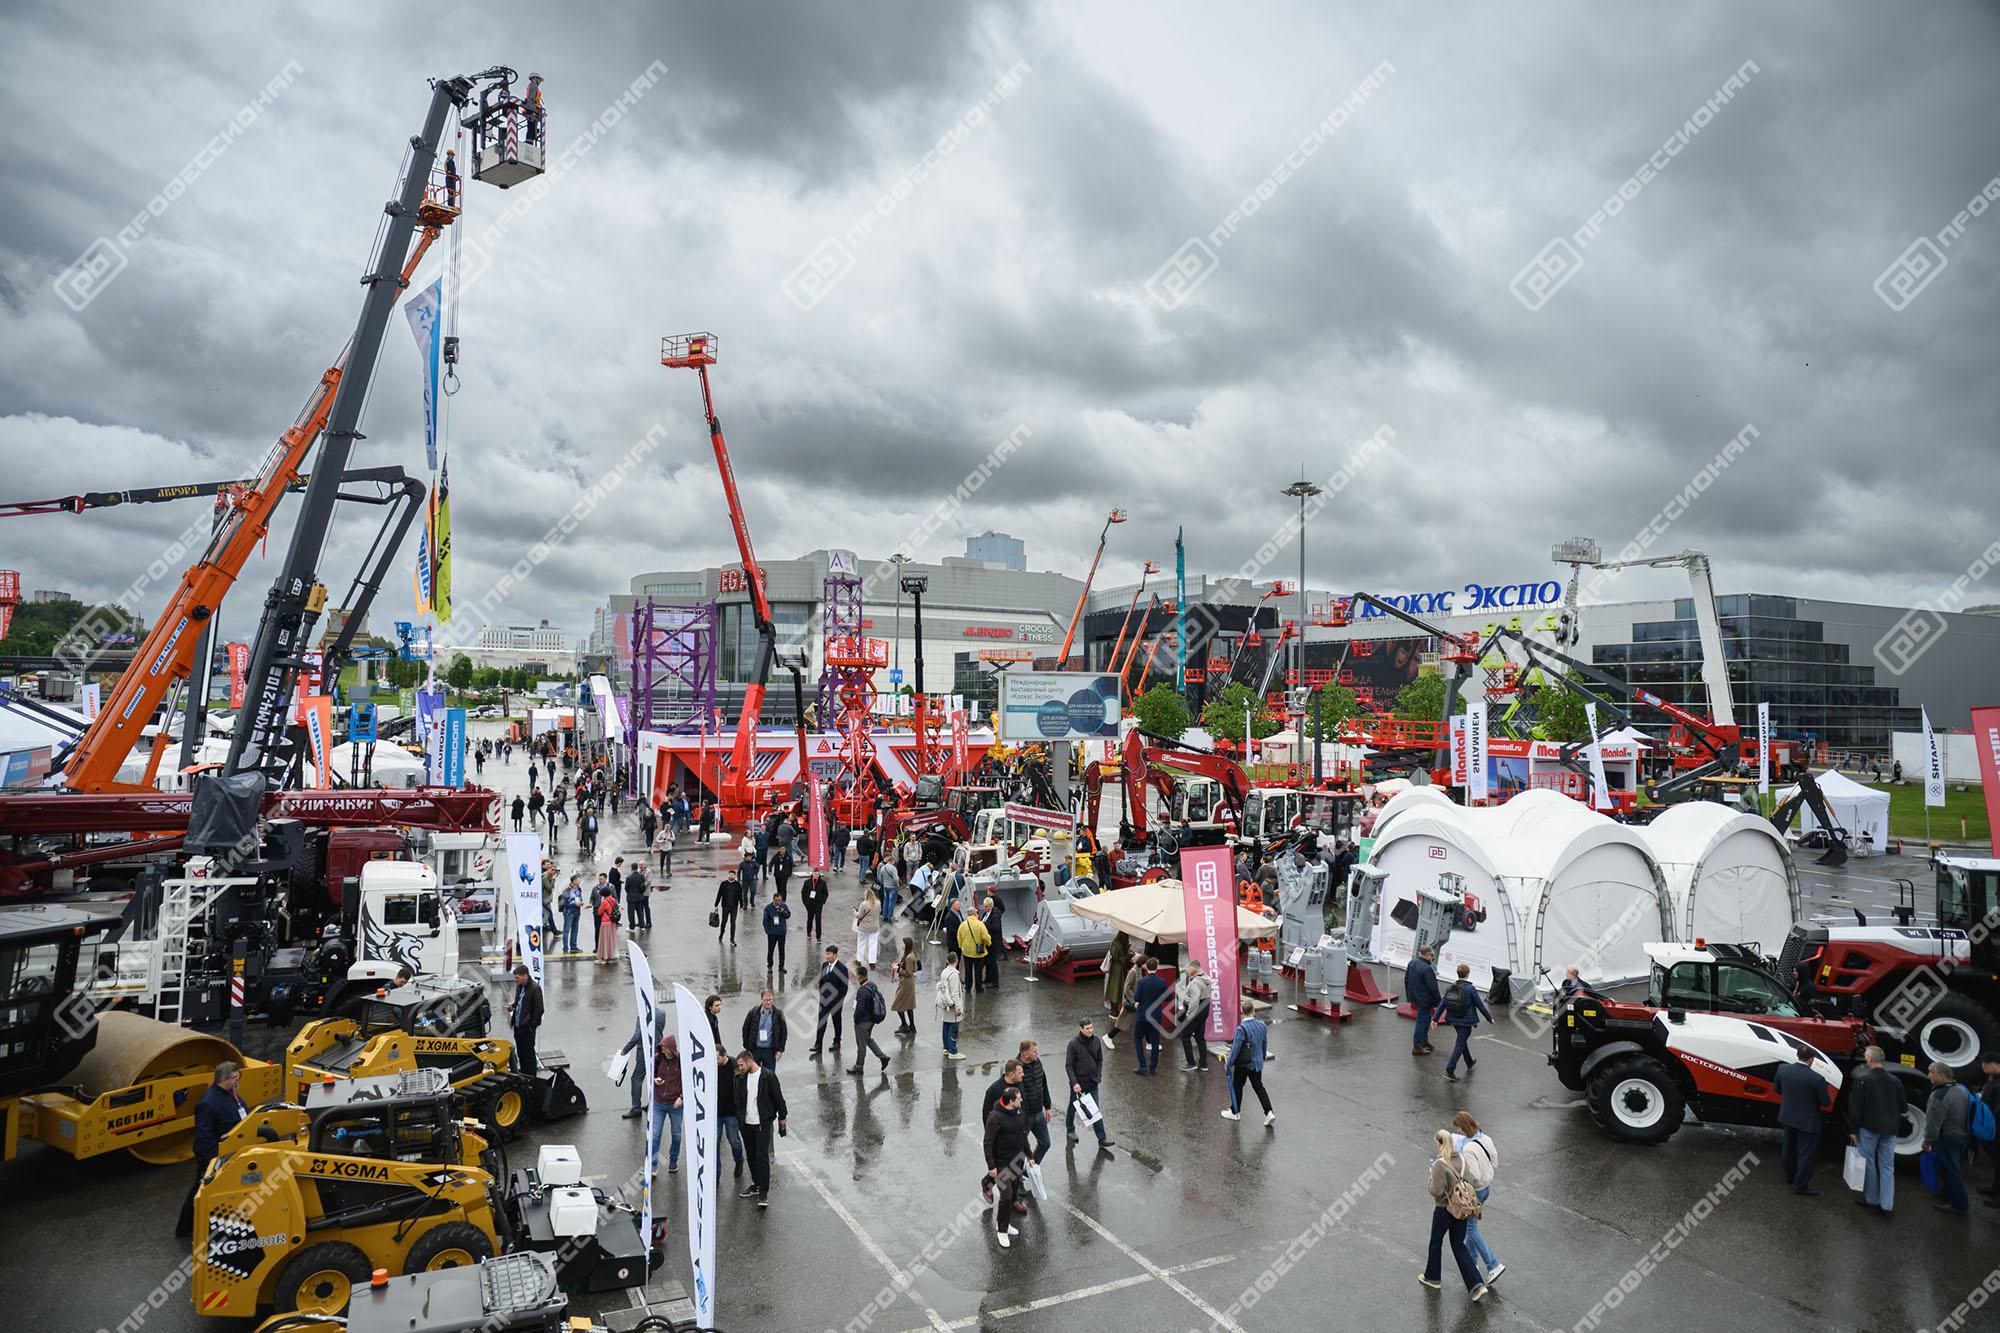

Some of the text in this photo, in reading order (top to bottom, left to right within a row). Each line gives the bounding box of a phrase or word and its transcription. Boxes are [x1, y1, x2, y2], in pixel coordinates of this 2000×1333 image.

[1463, 580, 1561, 610] ЭКСПО
[1019, 624, 1053, 632] CROCUS
[437, 719, 446, 768] AURORA
[427, 1040, 458, 1052] XGMA
[330, 1161, 389, 1180] XGMA
